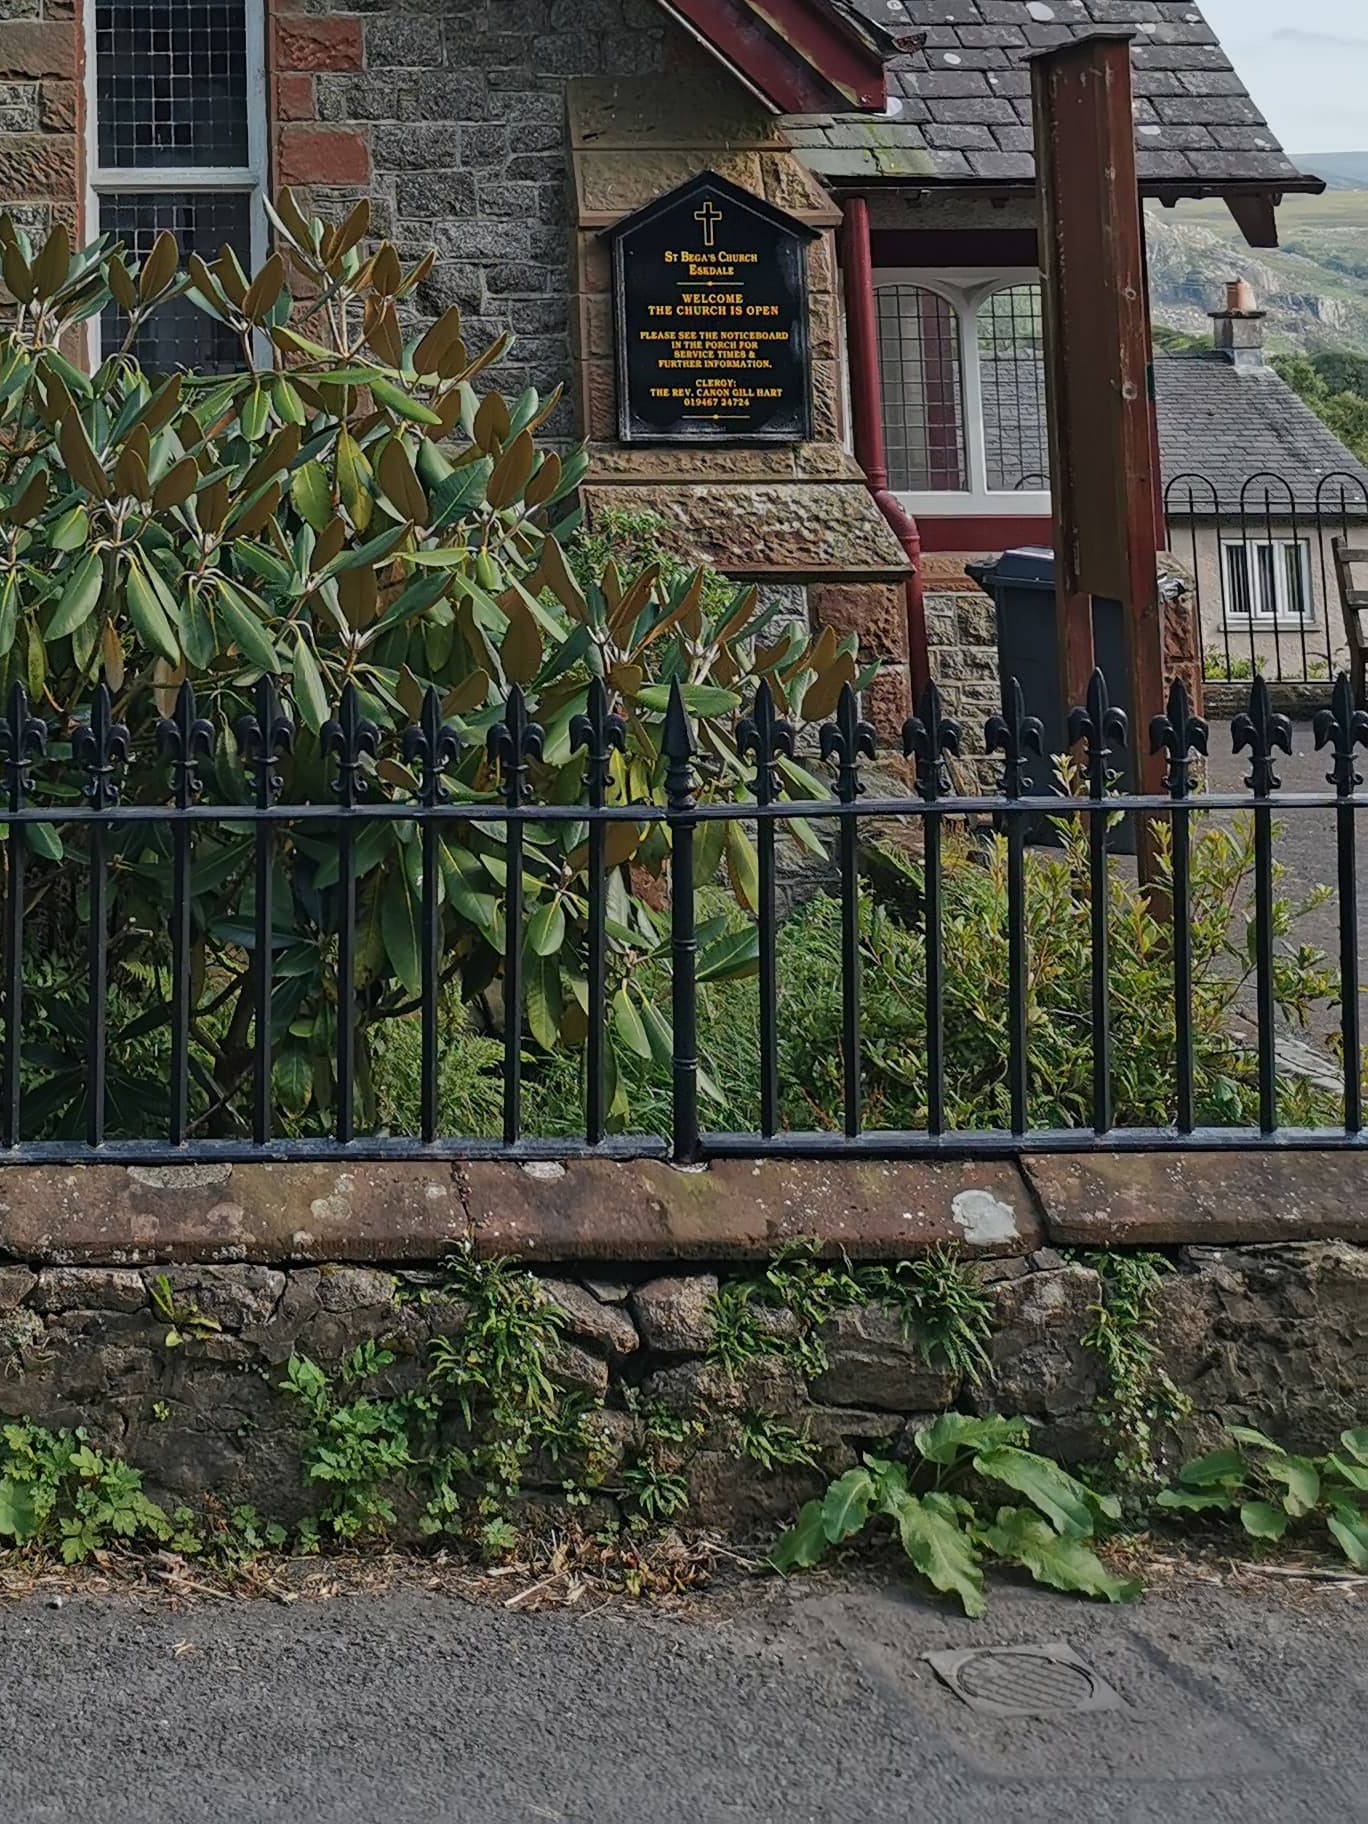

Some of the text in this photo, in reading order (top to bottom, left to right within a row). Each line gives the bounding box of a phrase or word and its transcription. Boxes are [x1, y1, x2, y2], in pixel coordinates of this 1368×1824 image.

[682, 293, 743, 304] WELCOME
[647, 305, 779, 316] THE CHURCH IS OPEN
[640, 331, 789, 340] PLEASE SEE THE NOTICEBOARD
[671, 341, 759, 349] IN THE PORCH FOR
[673, 350, 756, 359] SERVICE TIMES &
[658, 359, 702, 368] FURTHER
[695, 379, 737, 388] CLERGY:
[650, 388, 783, 397] THE REV. CANON GILL HART
